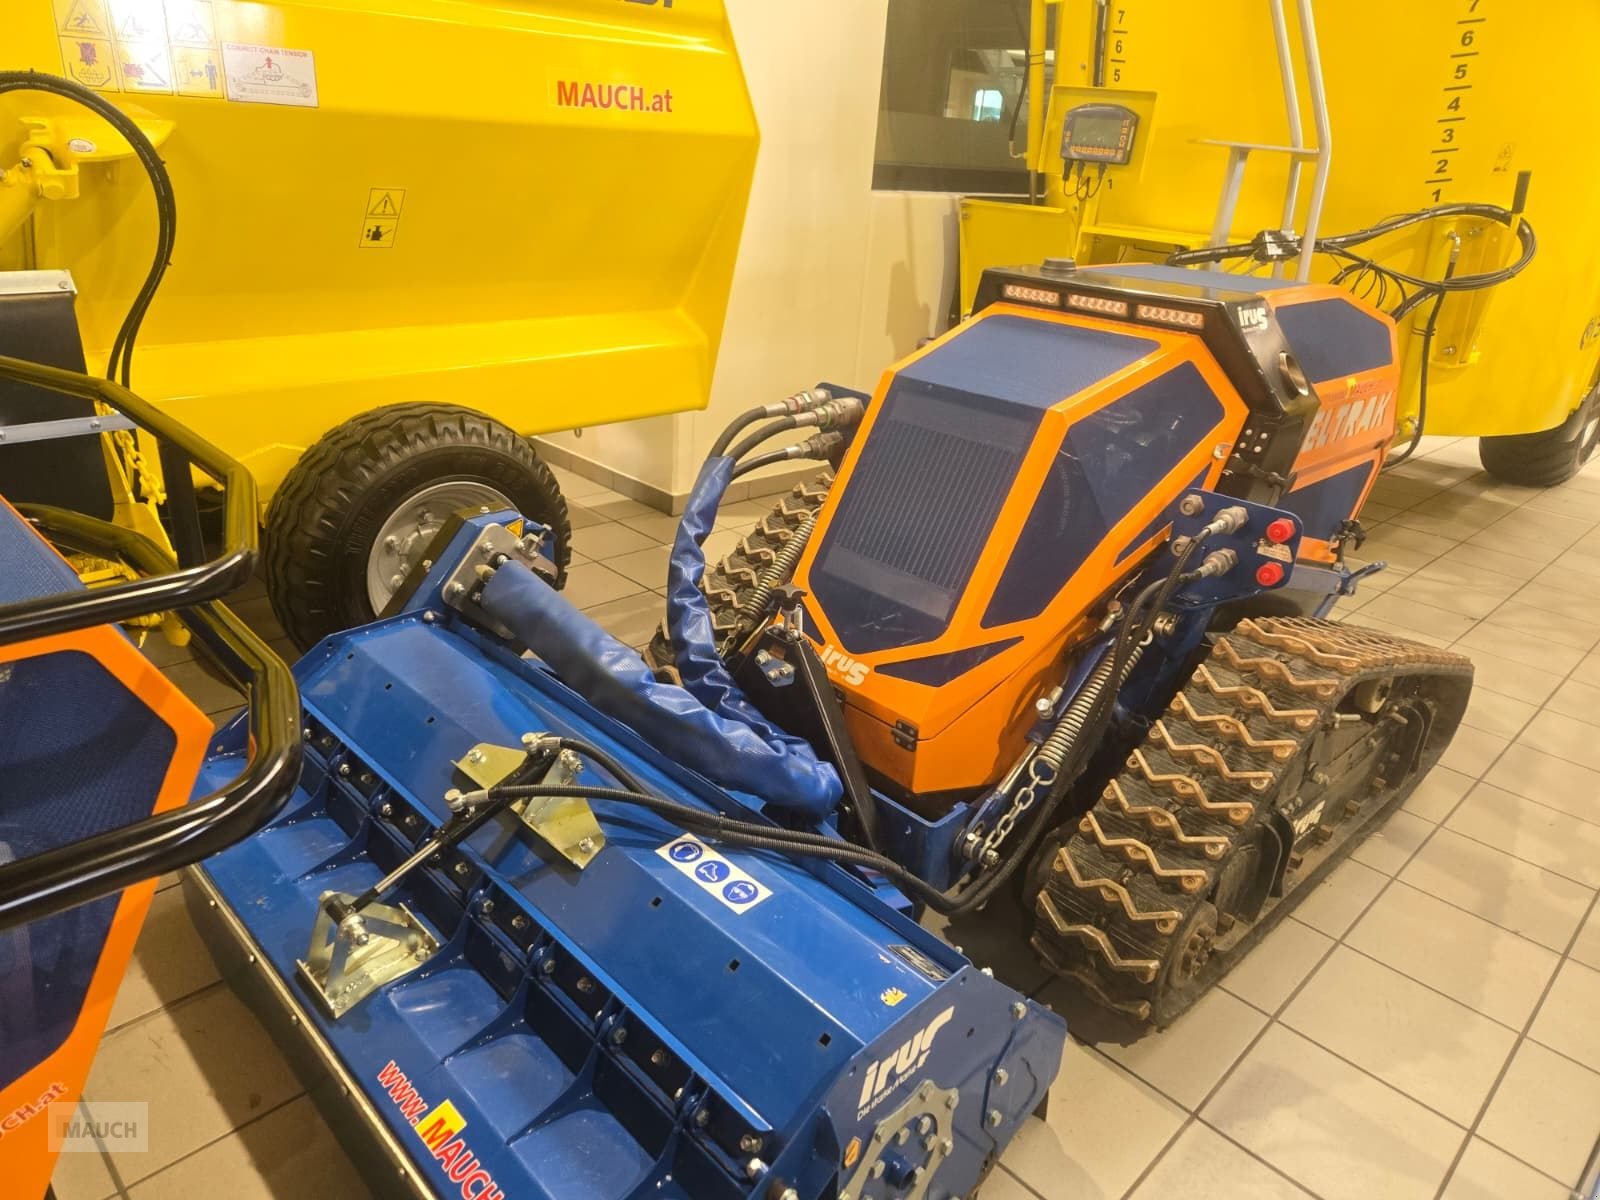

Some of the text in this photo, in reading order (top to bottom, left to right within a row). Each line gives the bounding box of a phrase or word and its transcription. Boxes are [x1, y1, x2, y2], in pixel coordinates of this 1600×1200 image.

[1466, 0, 1480, 13] 7
[1118, 10, 1126, 24] 7
[1461, 30, 1474, 46] 6
[1115, 40, 1122, 53] 6
[1113, 69, 1120, 82] 5
[1454, 64, 1468, 79] 5
[557, 80, 673, 112] MAUCH.at
[1447, 96, 1461, 111] 4
[1441, 128, 1454, 143] 3
[1434, 159, 1448, 174] 2
[1431, 189, 1442, 202] 1
[820, 644, 870, 686] irus
[0, 1082, 66, 1142] CH.at
